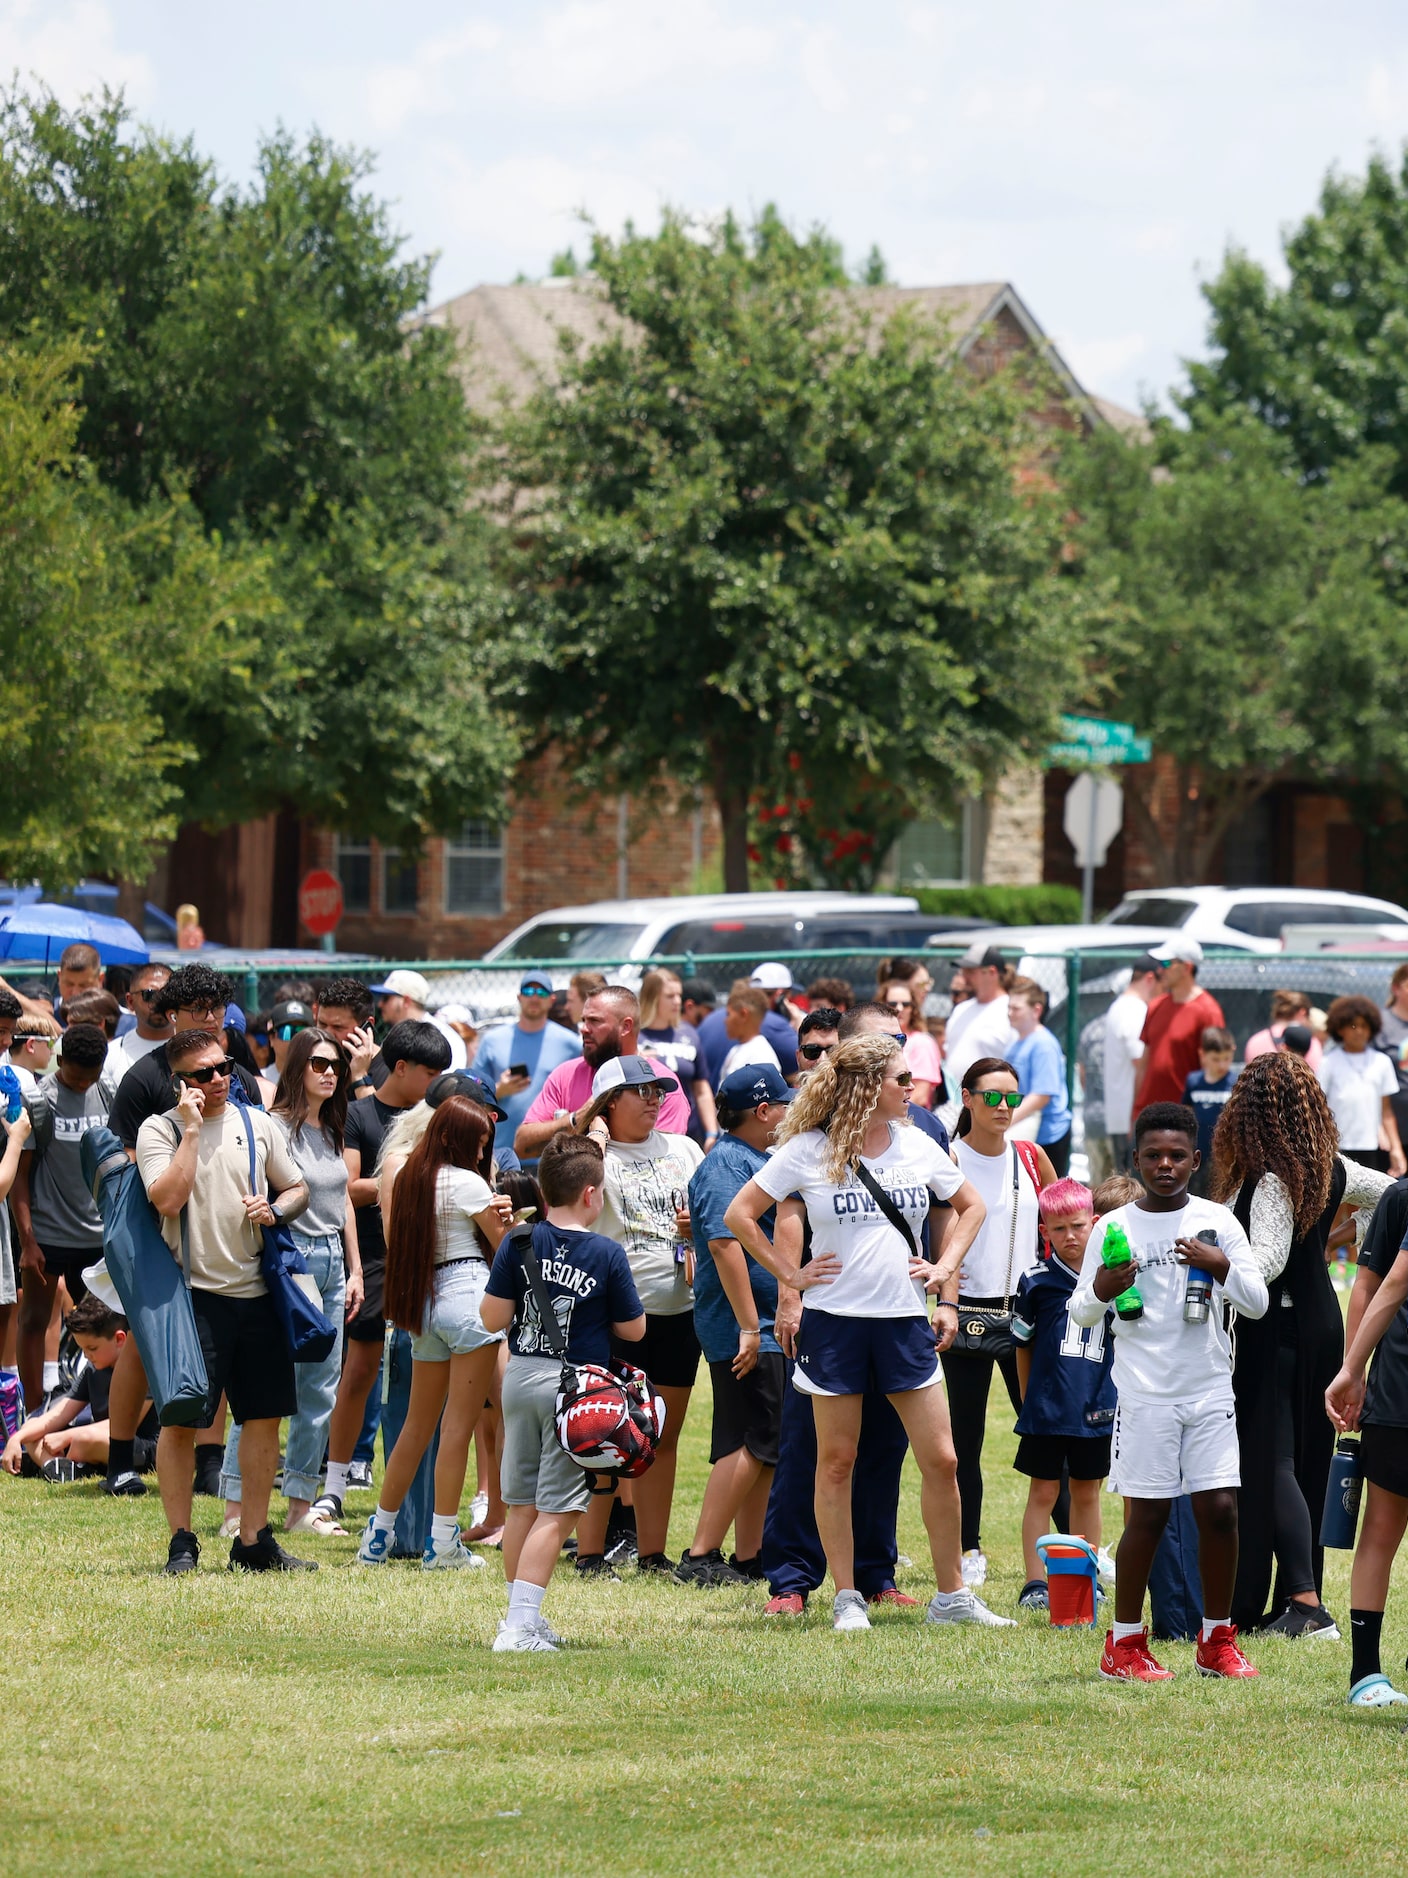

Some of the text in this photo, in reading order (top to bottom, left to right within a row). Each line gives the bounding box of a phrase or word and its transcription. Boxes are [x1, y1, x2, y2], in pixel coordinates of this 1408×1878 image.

[301, 888, 341, 919] STOP
[833, 1186, 928, 1215] COWOYS
[520, 1257, 597, 1298] RSONS
